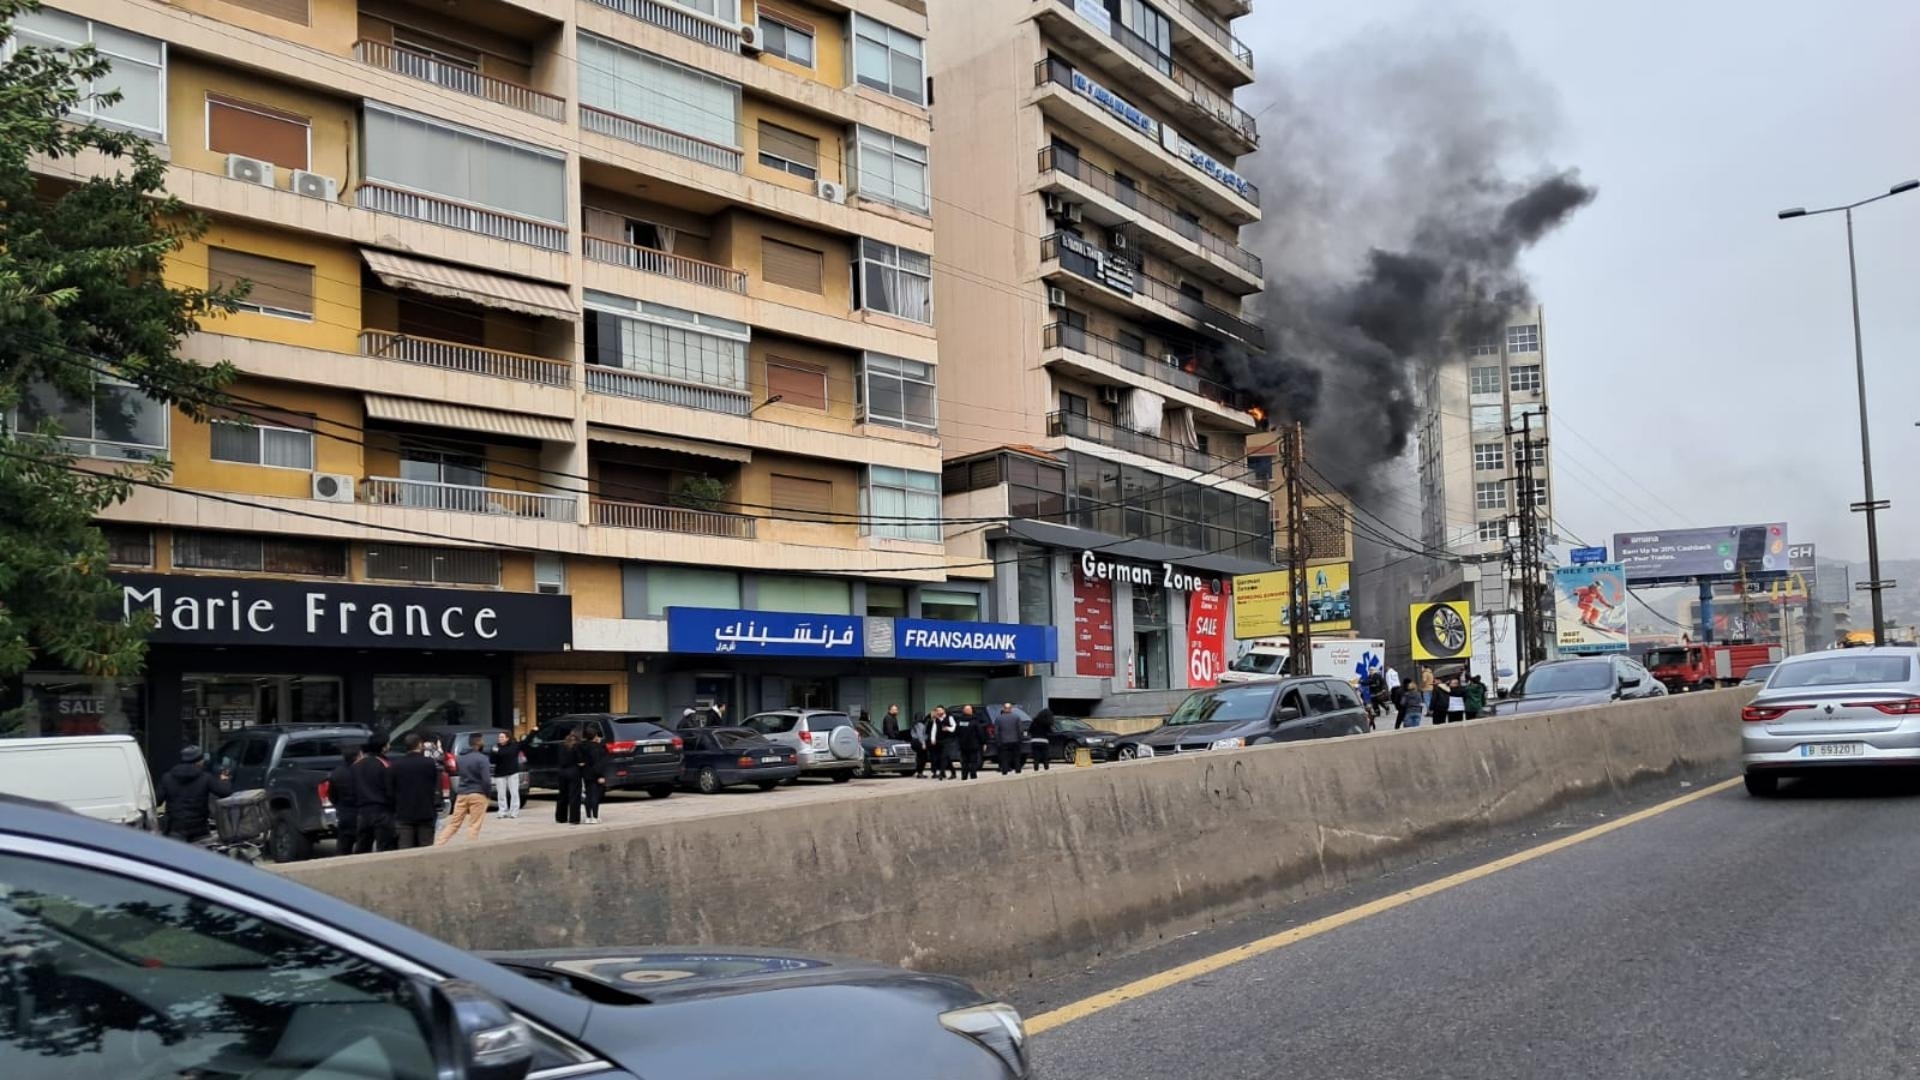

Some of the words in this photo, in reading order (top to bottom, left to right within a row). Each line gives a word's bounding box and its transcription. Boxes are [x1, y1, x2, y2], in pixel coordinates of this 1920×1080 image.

[1082, 550, 1152, 585] German
[1163, 563, 1202, 592] Zone
[1588, 565, 1621, 573] STYLE
[123, 585, 275, 632] Marie
[307, 592, 498, 639] France
[1196, 616, 1217, 635] SALE
[905, 629, 1017, 651] FRANSABANK
[59, 700, 105, 714] SALE
[1809, 745, 1816, 755] B
